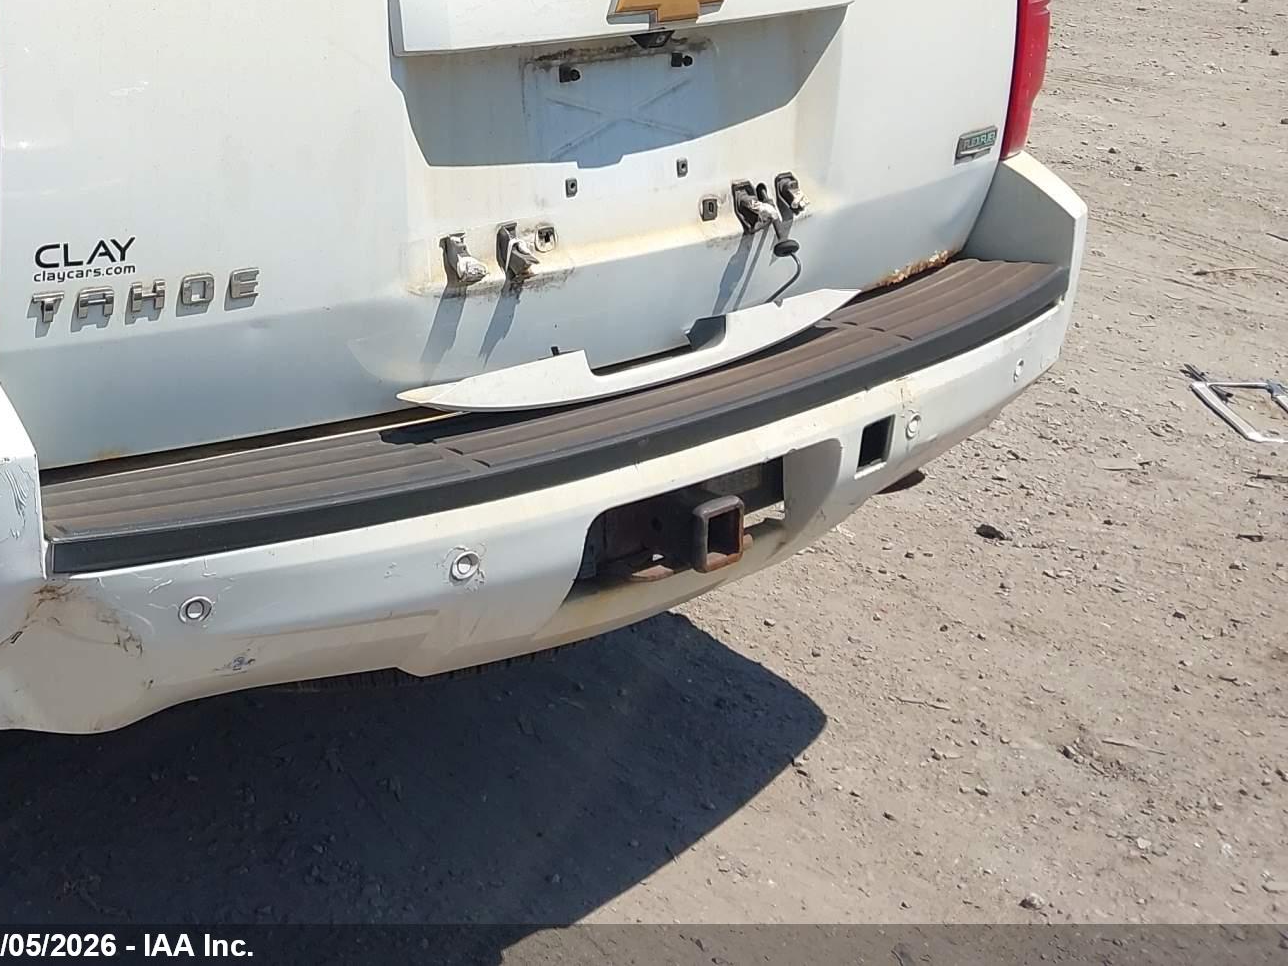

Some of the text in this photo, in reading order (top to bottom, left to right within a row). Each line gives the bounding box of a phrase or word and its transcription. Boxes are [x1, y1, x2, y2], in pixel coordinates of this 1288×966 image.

[34, 237, 136, 268] CLAY
[33, 264, 136, 283] claycars.com
[31, 267, 260, 323] TAHOE
